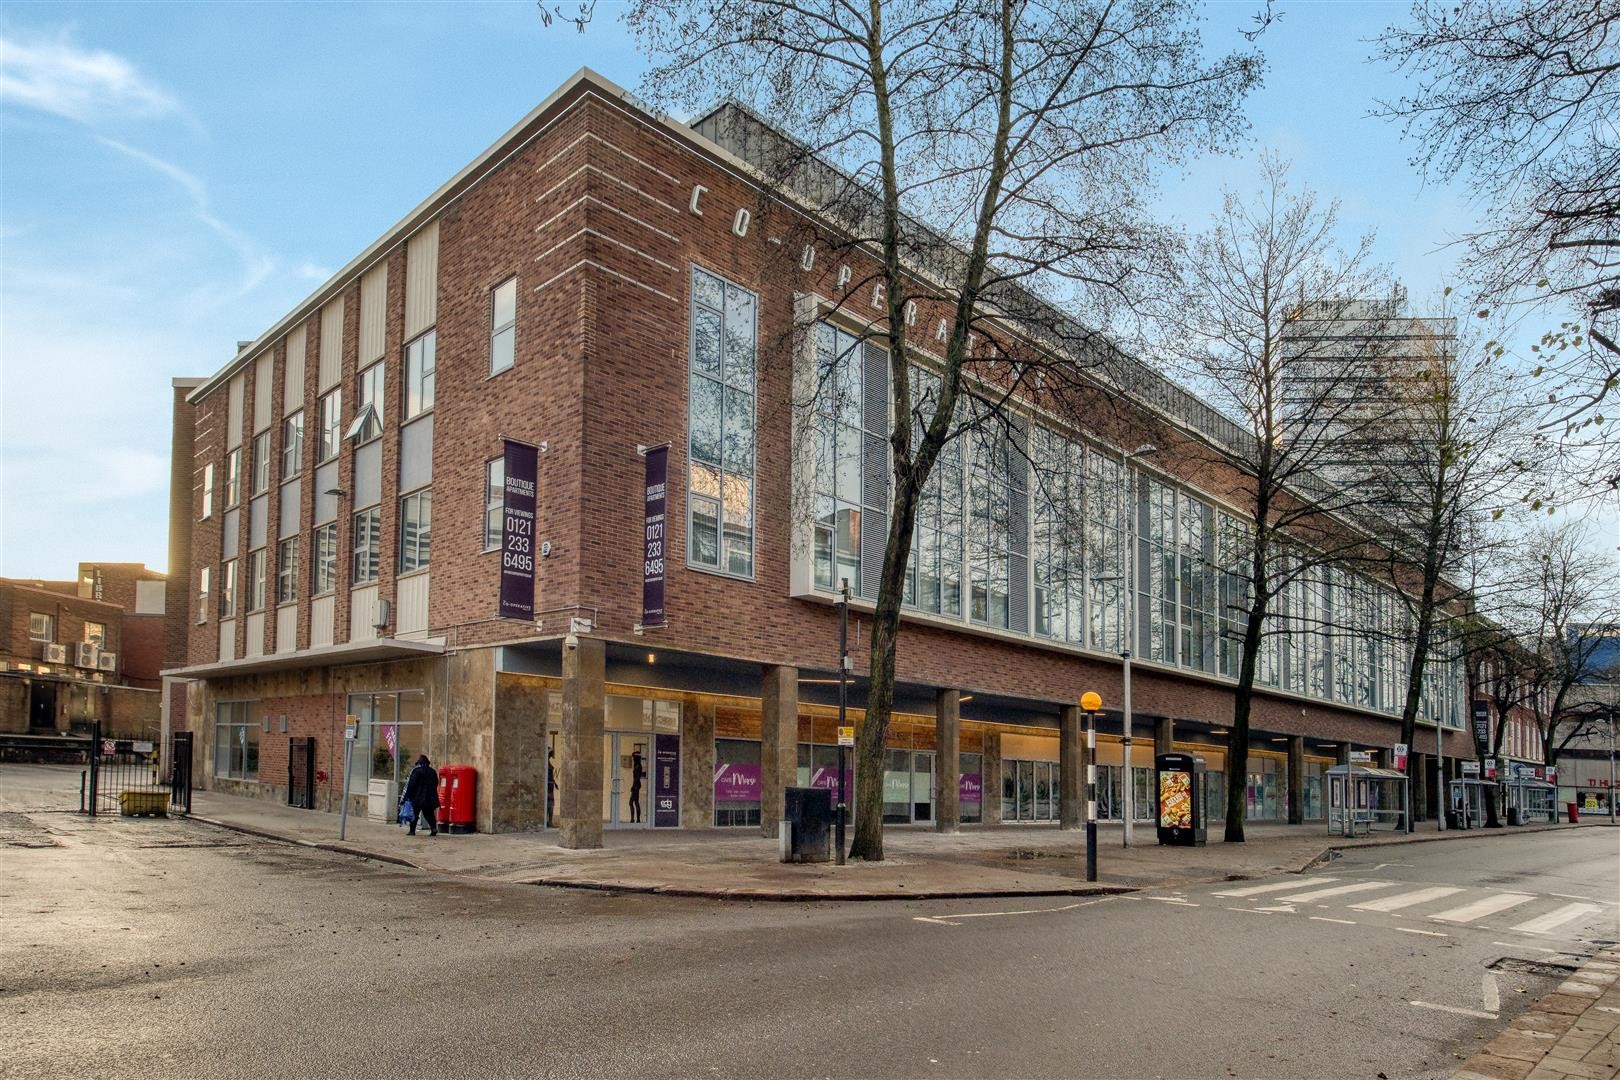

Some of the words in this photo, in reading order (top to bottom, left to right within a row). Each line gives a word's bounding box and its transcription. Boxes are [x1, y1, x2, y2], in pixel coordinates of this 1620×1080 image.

[506, 476, 535, 490] BOUTIQUE
[506, 485, 535, 497] APARTMENTS
[514, 509, 534, 519] VIEWINGS
[506, 516, 531, 535] 0121
[646, 523, 663, 540] 0121
[508, 535, 529, 552] 233
[648, 541, 662, 558] 233
[503, 552, 532, 571] 6495
[645, 558, 664, 575] 6495
[96, 570, 104, 601] LIBR
